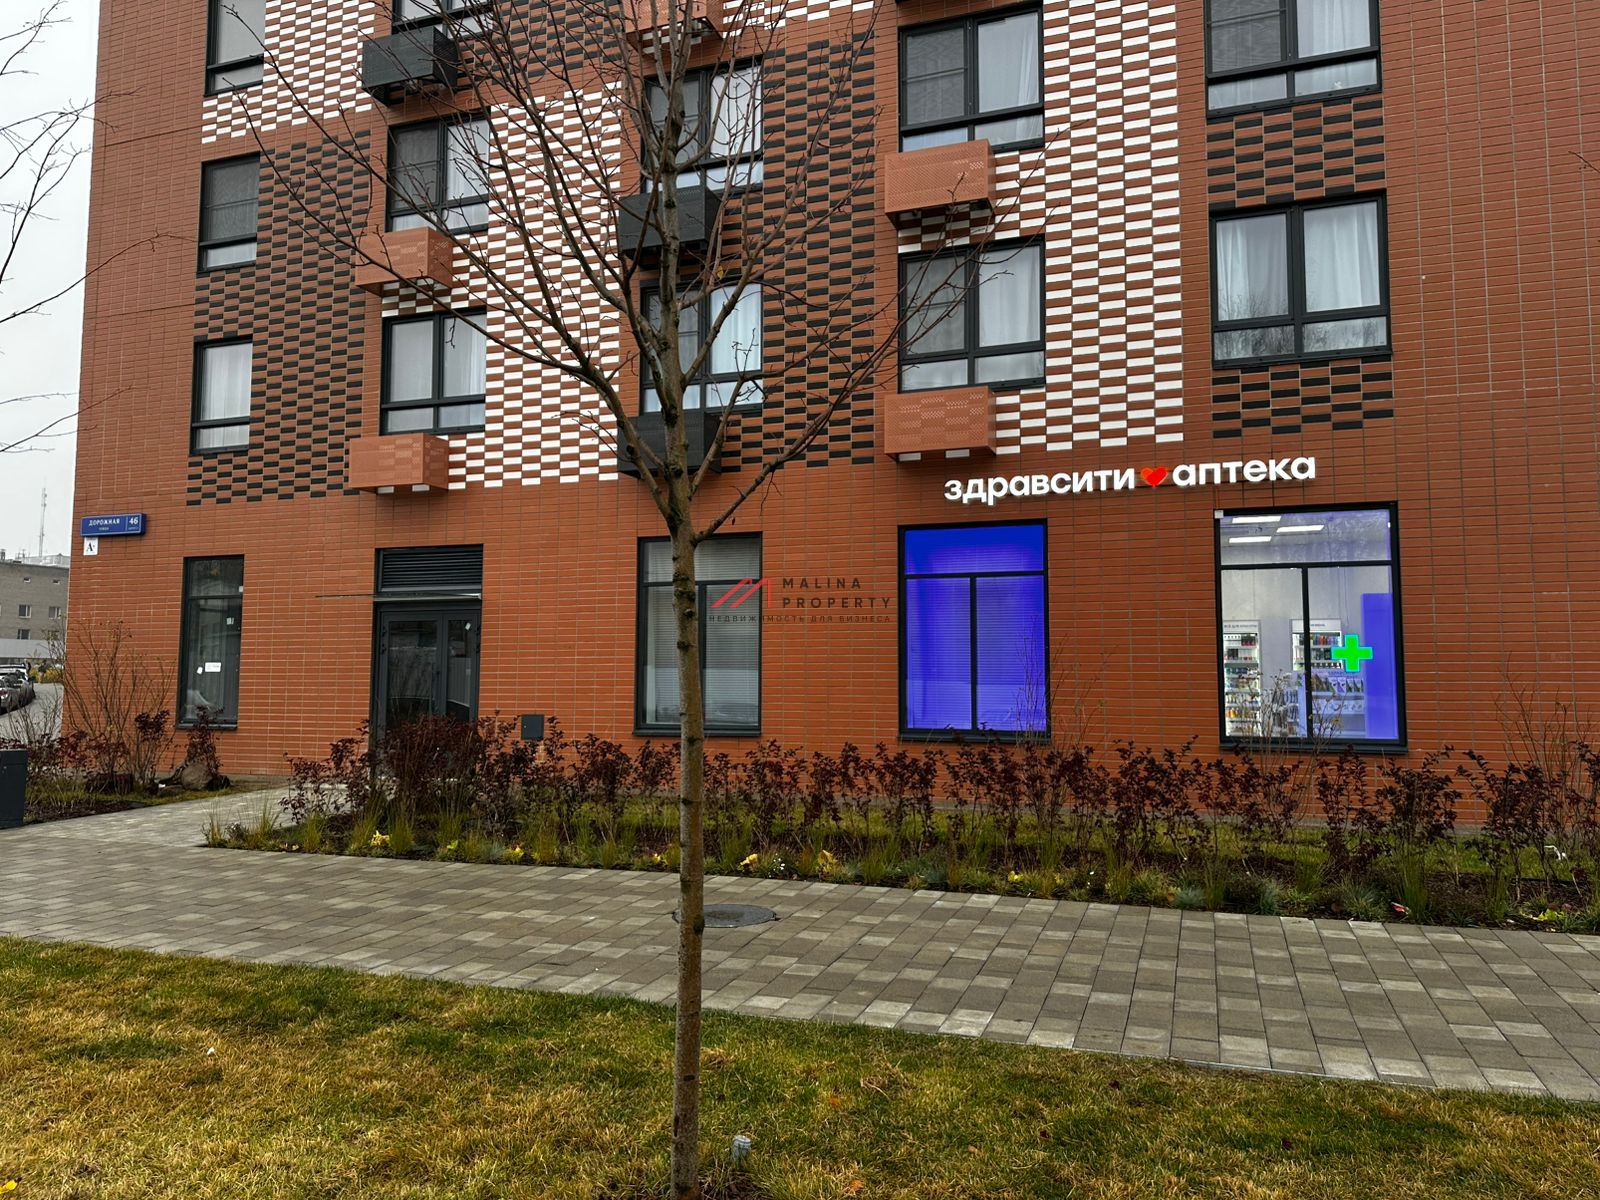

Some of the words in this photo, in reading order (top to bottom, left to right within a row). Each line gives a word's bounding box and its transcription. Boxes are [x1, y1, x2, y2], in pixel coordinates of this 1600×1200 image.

[943, 468, 1136, 506] здравсити
[1172, 456, 1316, 487] аптека
[88, 518, 120, 526] ДОРОЖНАЯ
[129, 516, 139, 525] 46
